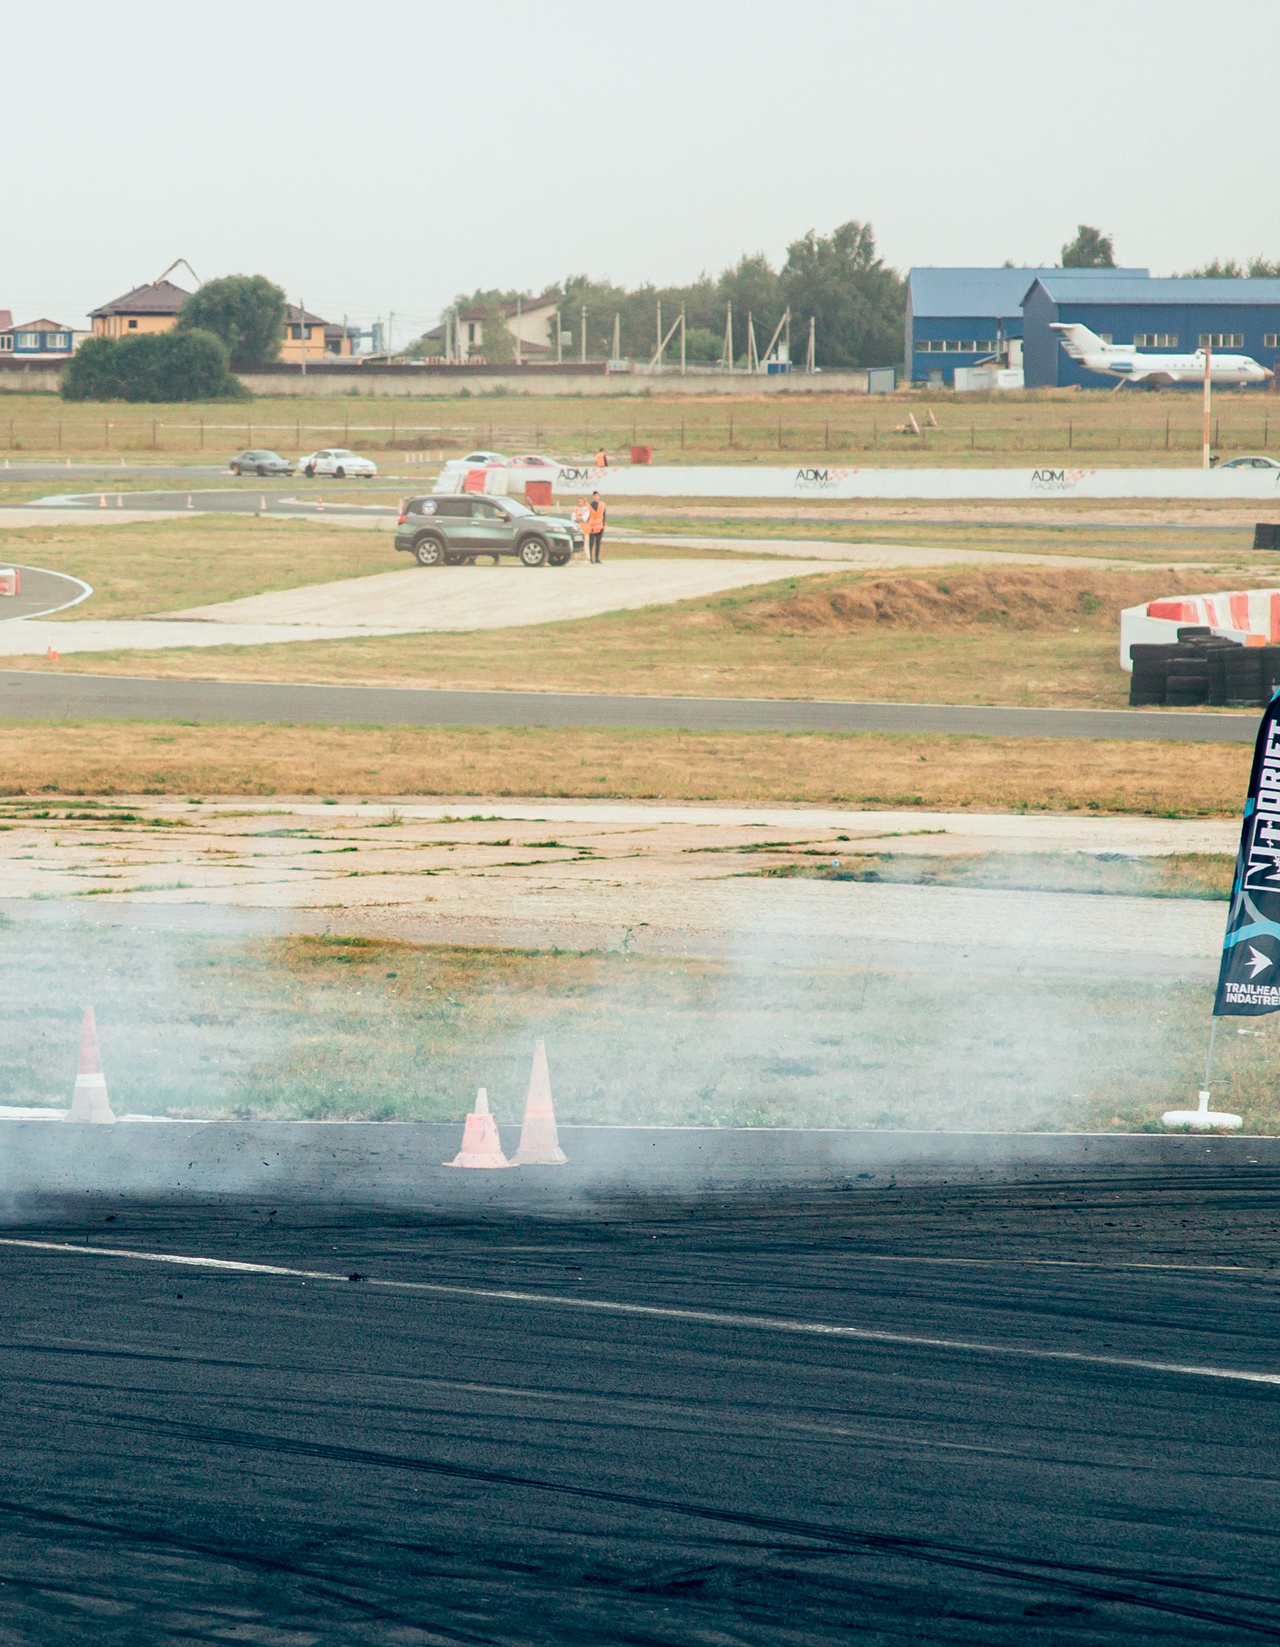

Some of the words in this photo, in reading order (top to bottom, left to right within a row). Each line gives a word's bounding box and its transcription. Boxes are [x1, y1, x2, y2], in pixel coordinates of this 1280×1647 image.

[557, 468, 588, 480] ADM
[796, 469, 828, 481] ADM
[1031, 470, 1064, 481] ADM
[1225, 982, 1280, 996] TRAILHEA
[1226, 993, 1280, 1006] INDASTRE
